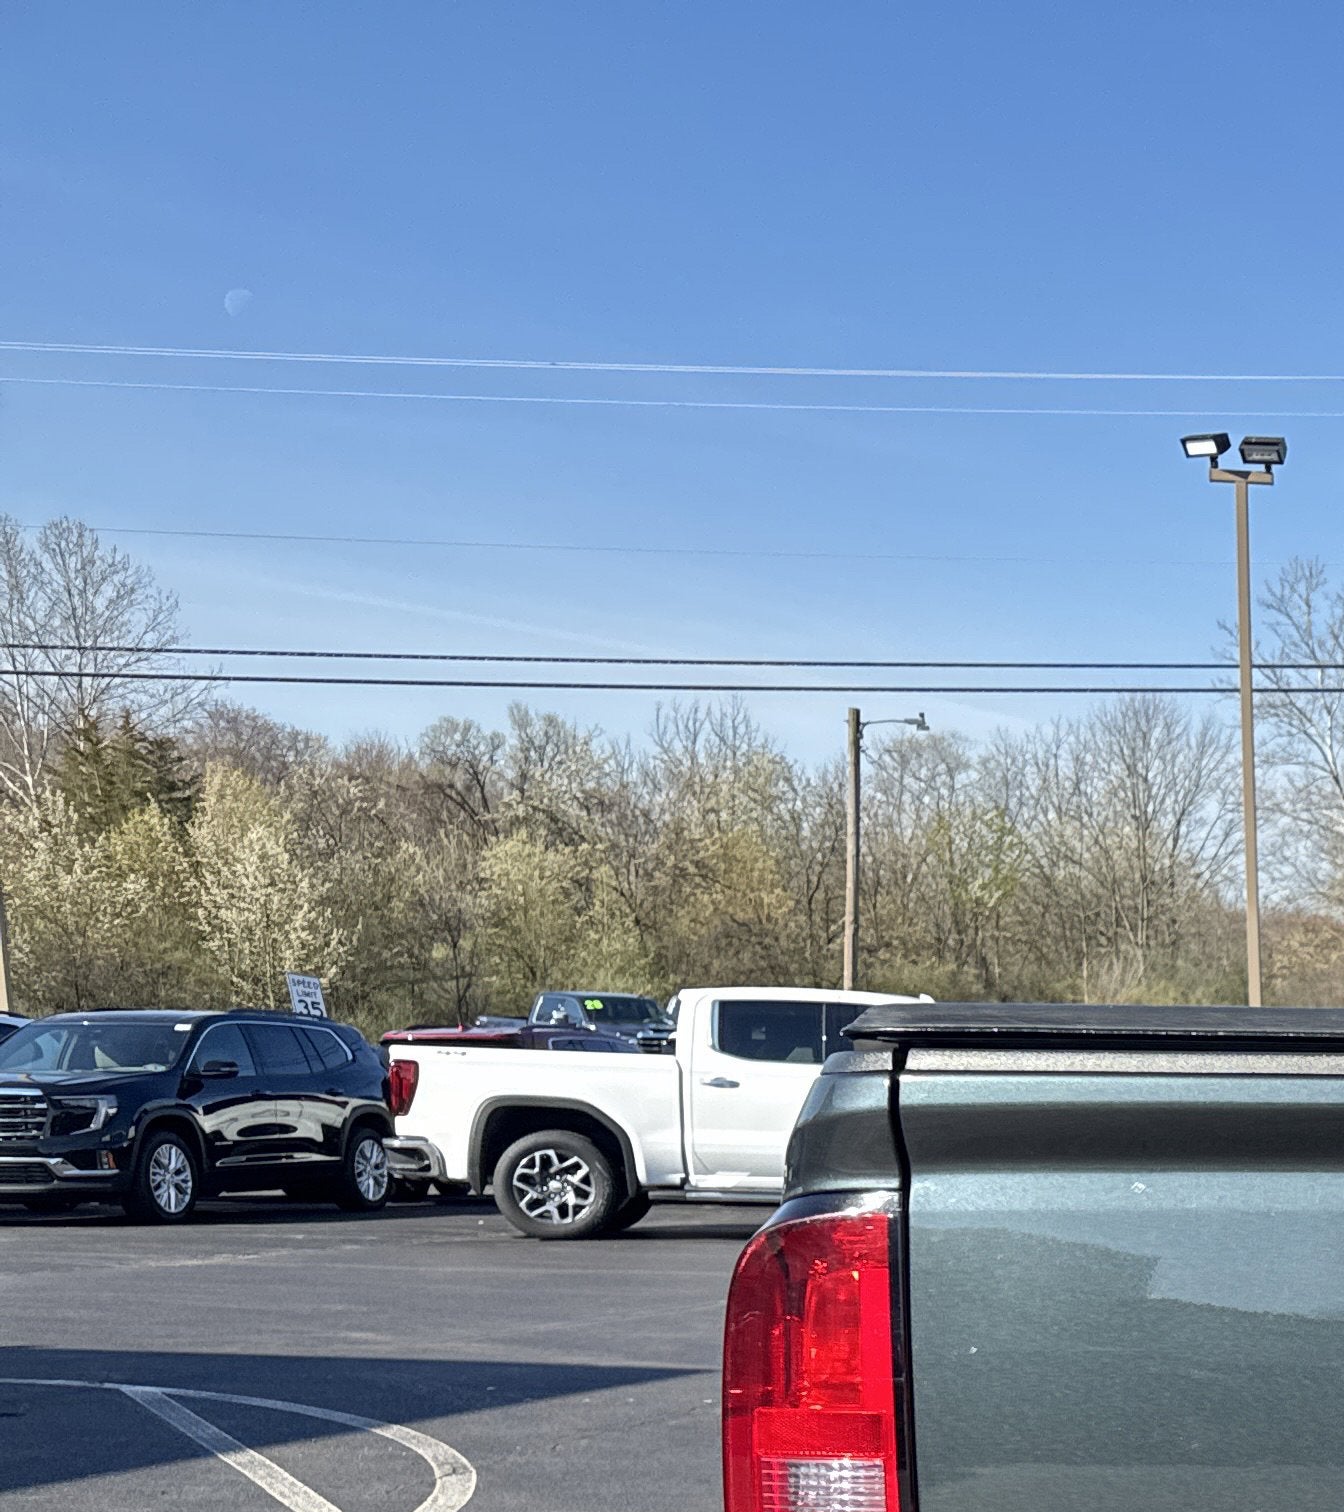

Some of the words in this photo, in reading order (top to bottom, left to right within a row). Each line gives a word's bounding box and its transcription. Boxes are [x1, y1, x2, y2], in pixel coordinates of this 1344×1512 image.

[291, 977, 319, 990] SPEED
[296, 989, 317, 999] LIMIT
[297, 999, 323, 1018] 35
